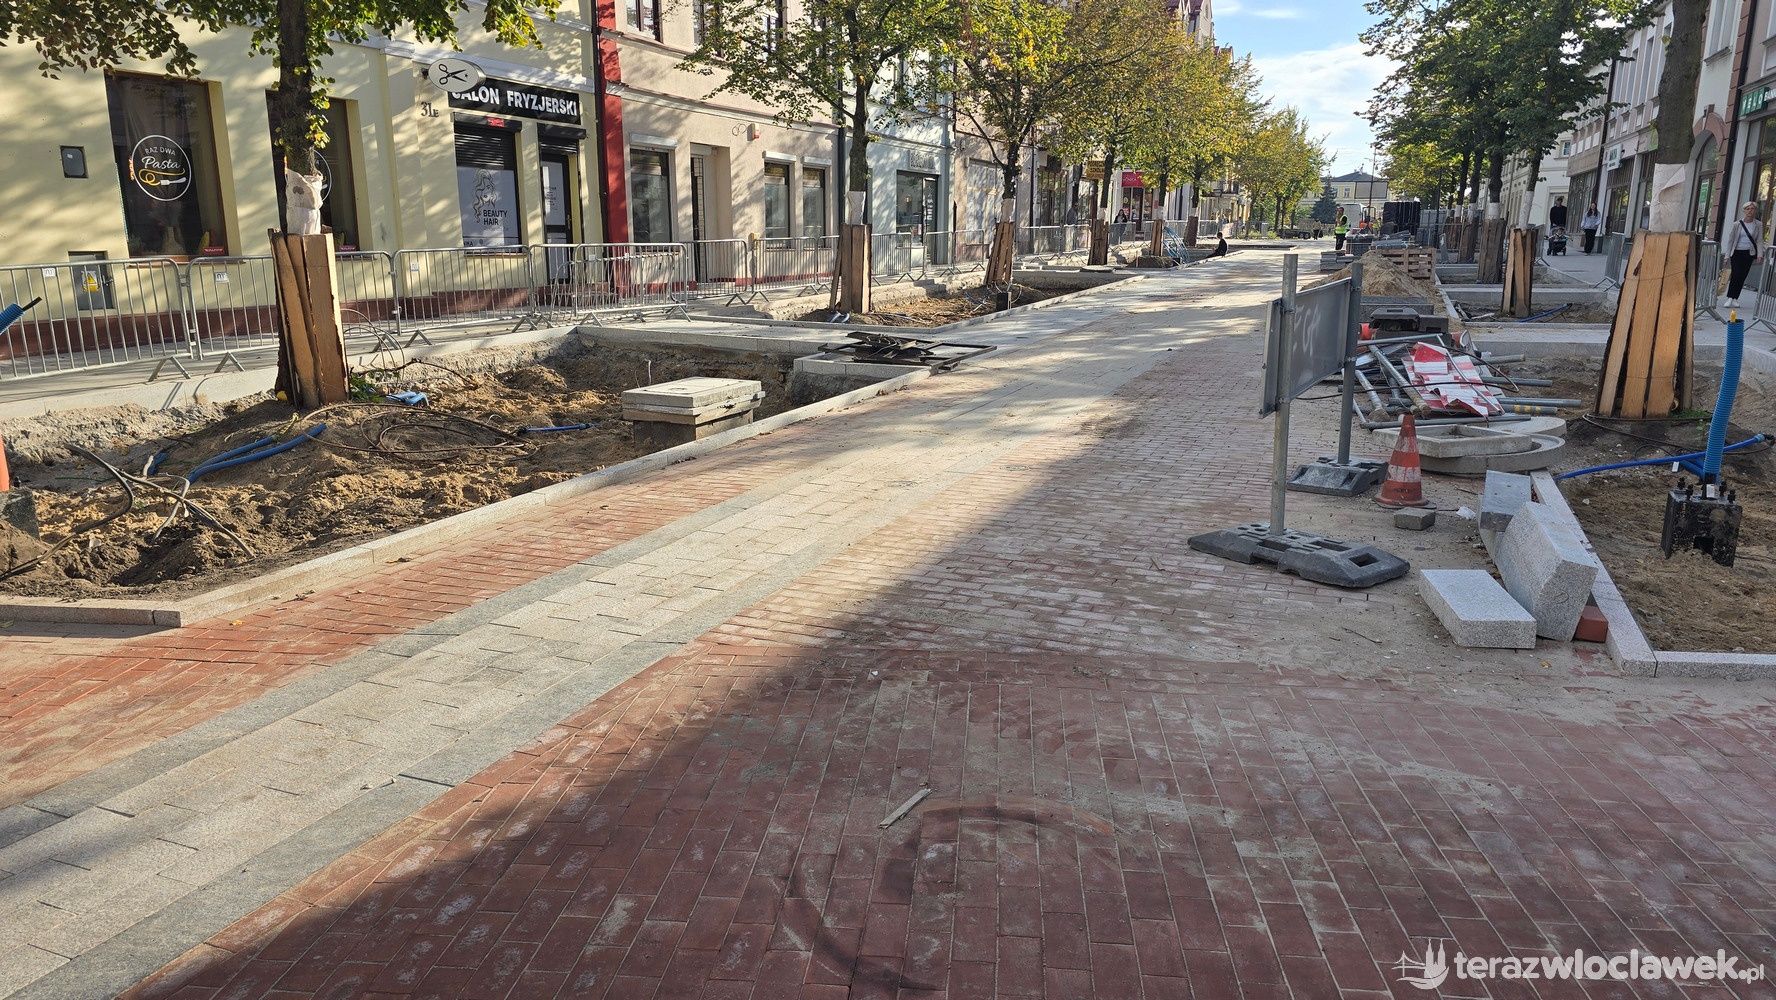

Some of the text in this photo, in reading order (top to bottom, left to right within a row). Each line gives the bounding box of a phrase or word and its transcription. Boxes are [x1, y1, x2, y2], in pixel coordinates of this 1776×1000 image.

[507, 91, 577, 116] FRYZJERSKI
[160, 147, 175, 155] DWA
[142, 156, 180, 169] Pasta
[483, 209, 508, 218] BEAUTY
[483, 218, 500, 226] HAIR
